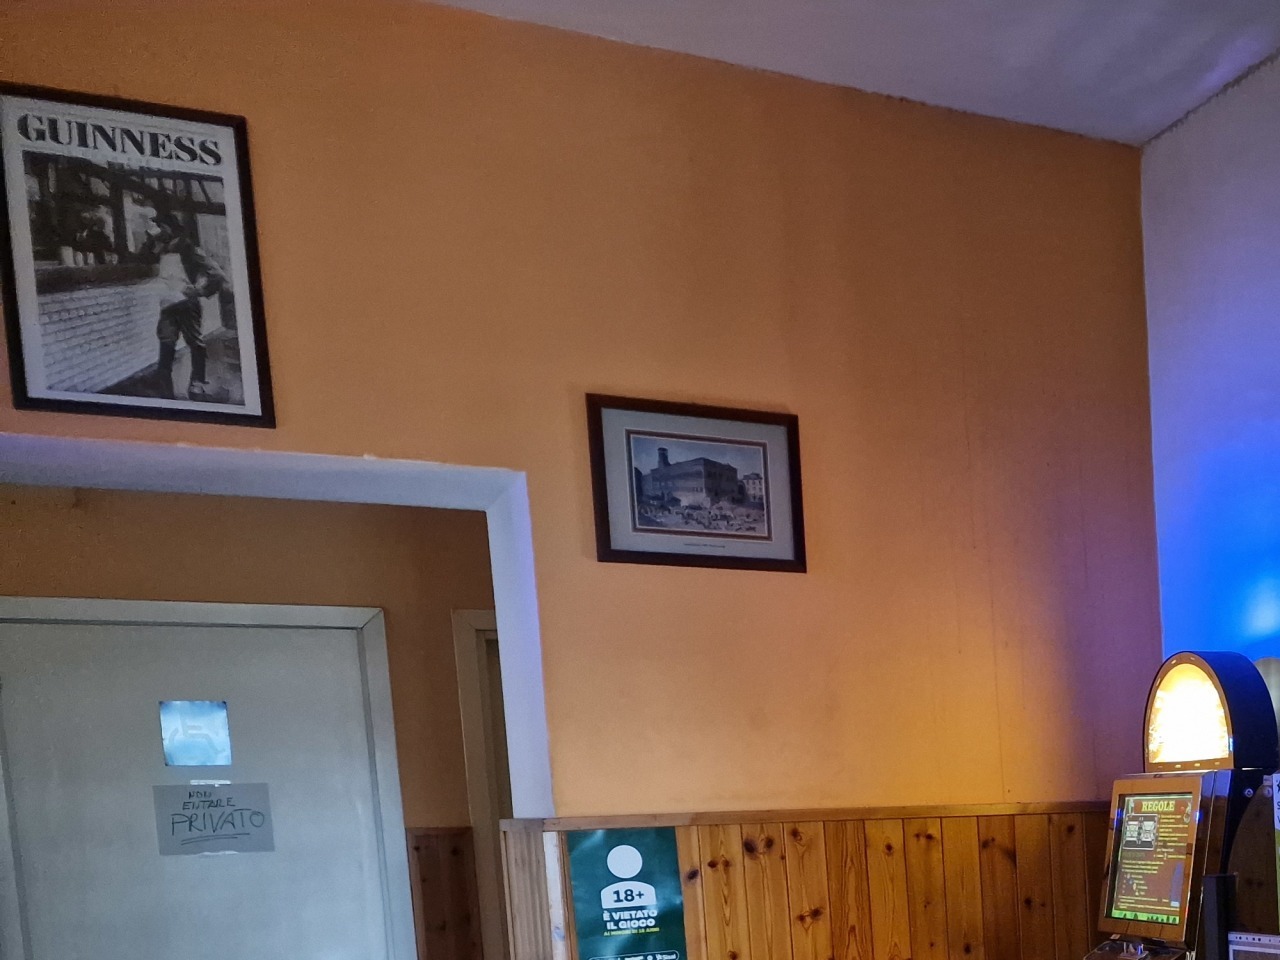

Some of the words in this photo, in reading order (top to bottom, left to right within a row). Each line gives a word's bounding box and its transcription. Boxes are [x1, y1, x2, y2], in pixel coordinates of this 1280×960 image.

[17, 112, 223, 167] GUINNESS
[1142, 800, 1175, 811] REGOLE
[170, 809, 265, 836] PRIVATO
[613, 889, 644, 903] 18+
[603, 911, 610, 921] È
[612, 910, 657, 920] VIETATO
[607, 921, 617, 930] IL
[619, 918, 655, 929] GIOCO
